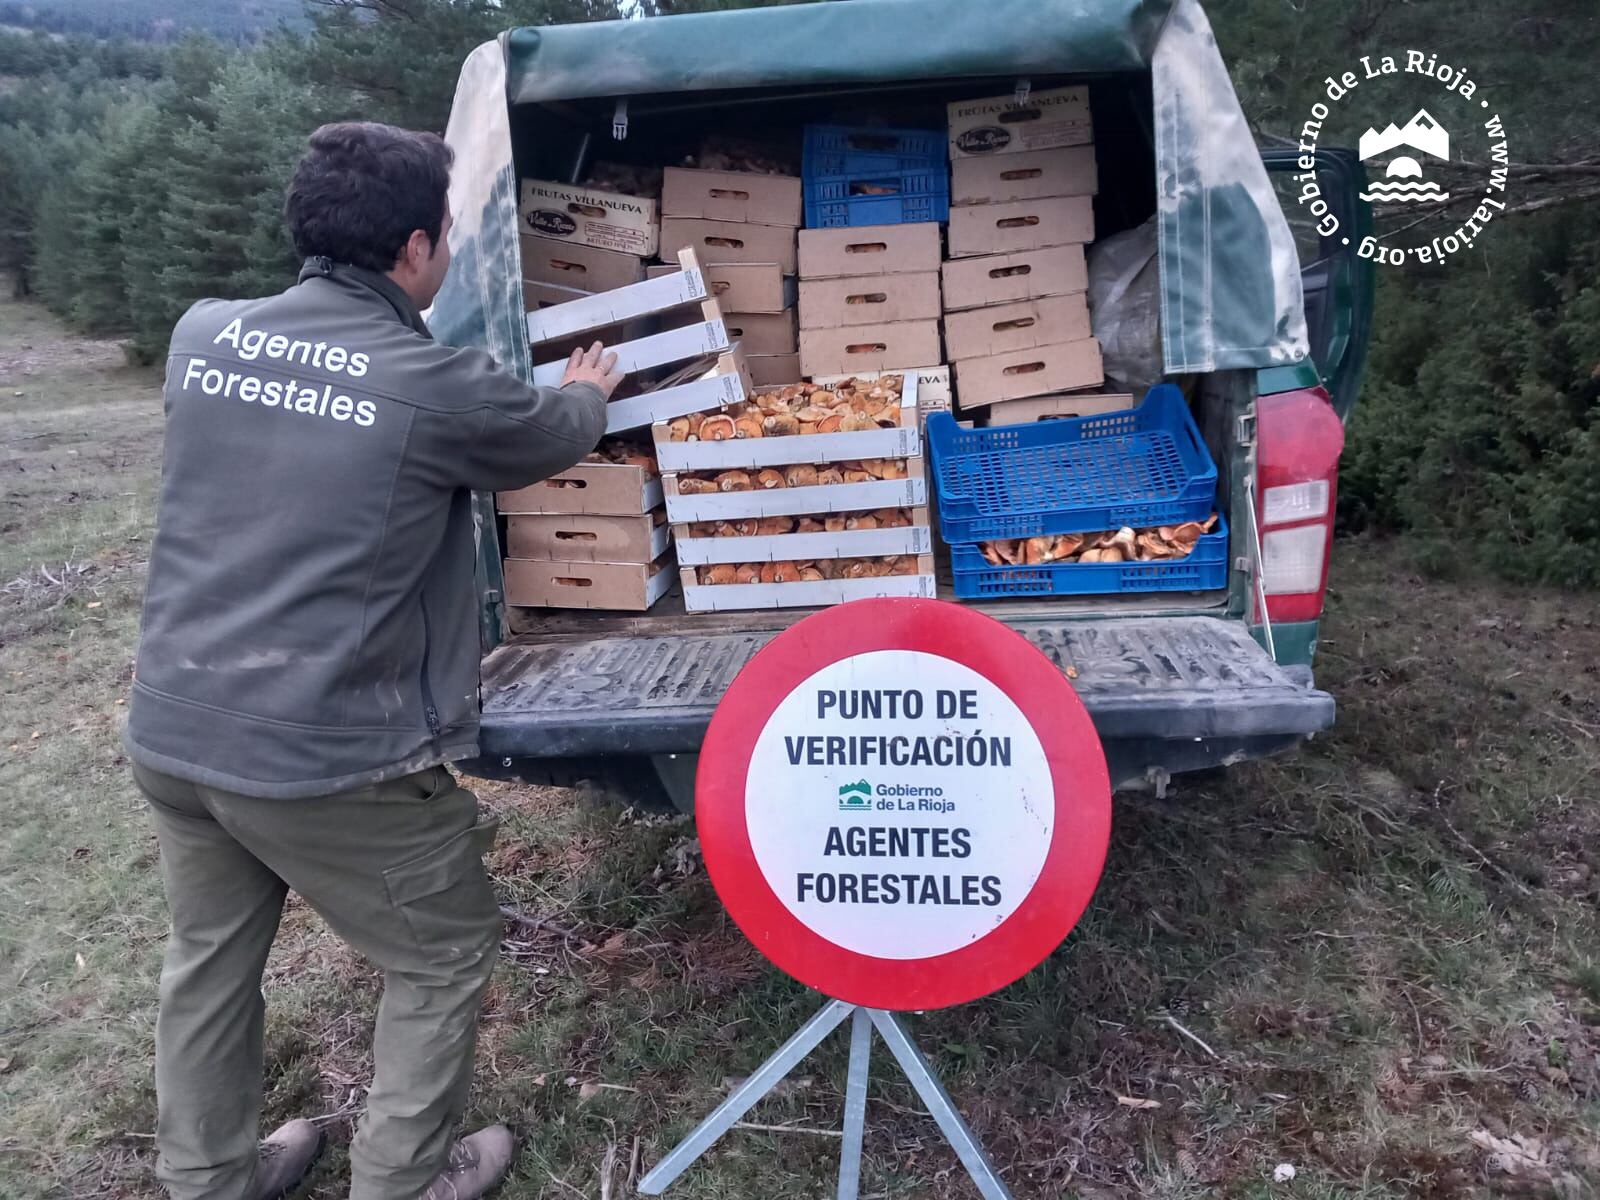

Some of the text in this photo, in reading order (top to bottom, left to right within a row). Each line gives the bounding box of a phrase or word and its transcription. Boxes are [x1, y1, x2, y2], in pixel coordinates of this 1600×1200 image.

[957, 105, 1001, 118] FRUTAS
[531, 187, 642, 214] FRUTAS VILLANUEVA
[213, 318, 370, 377] Agentes
[182, 358, 377, 426] Forestales
[817, 689, 978, 720] PUNTO DE
[784, 729, 1012, 766] VERIFICACIÓN
[876, 784, 943, 797] Gobierno
[876, 799, 956, 813] de La Rioja
[823, 826, 972, 858] AGENTES
[796, 873, 1002, 906] FORESTALES
